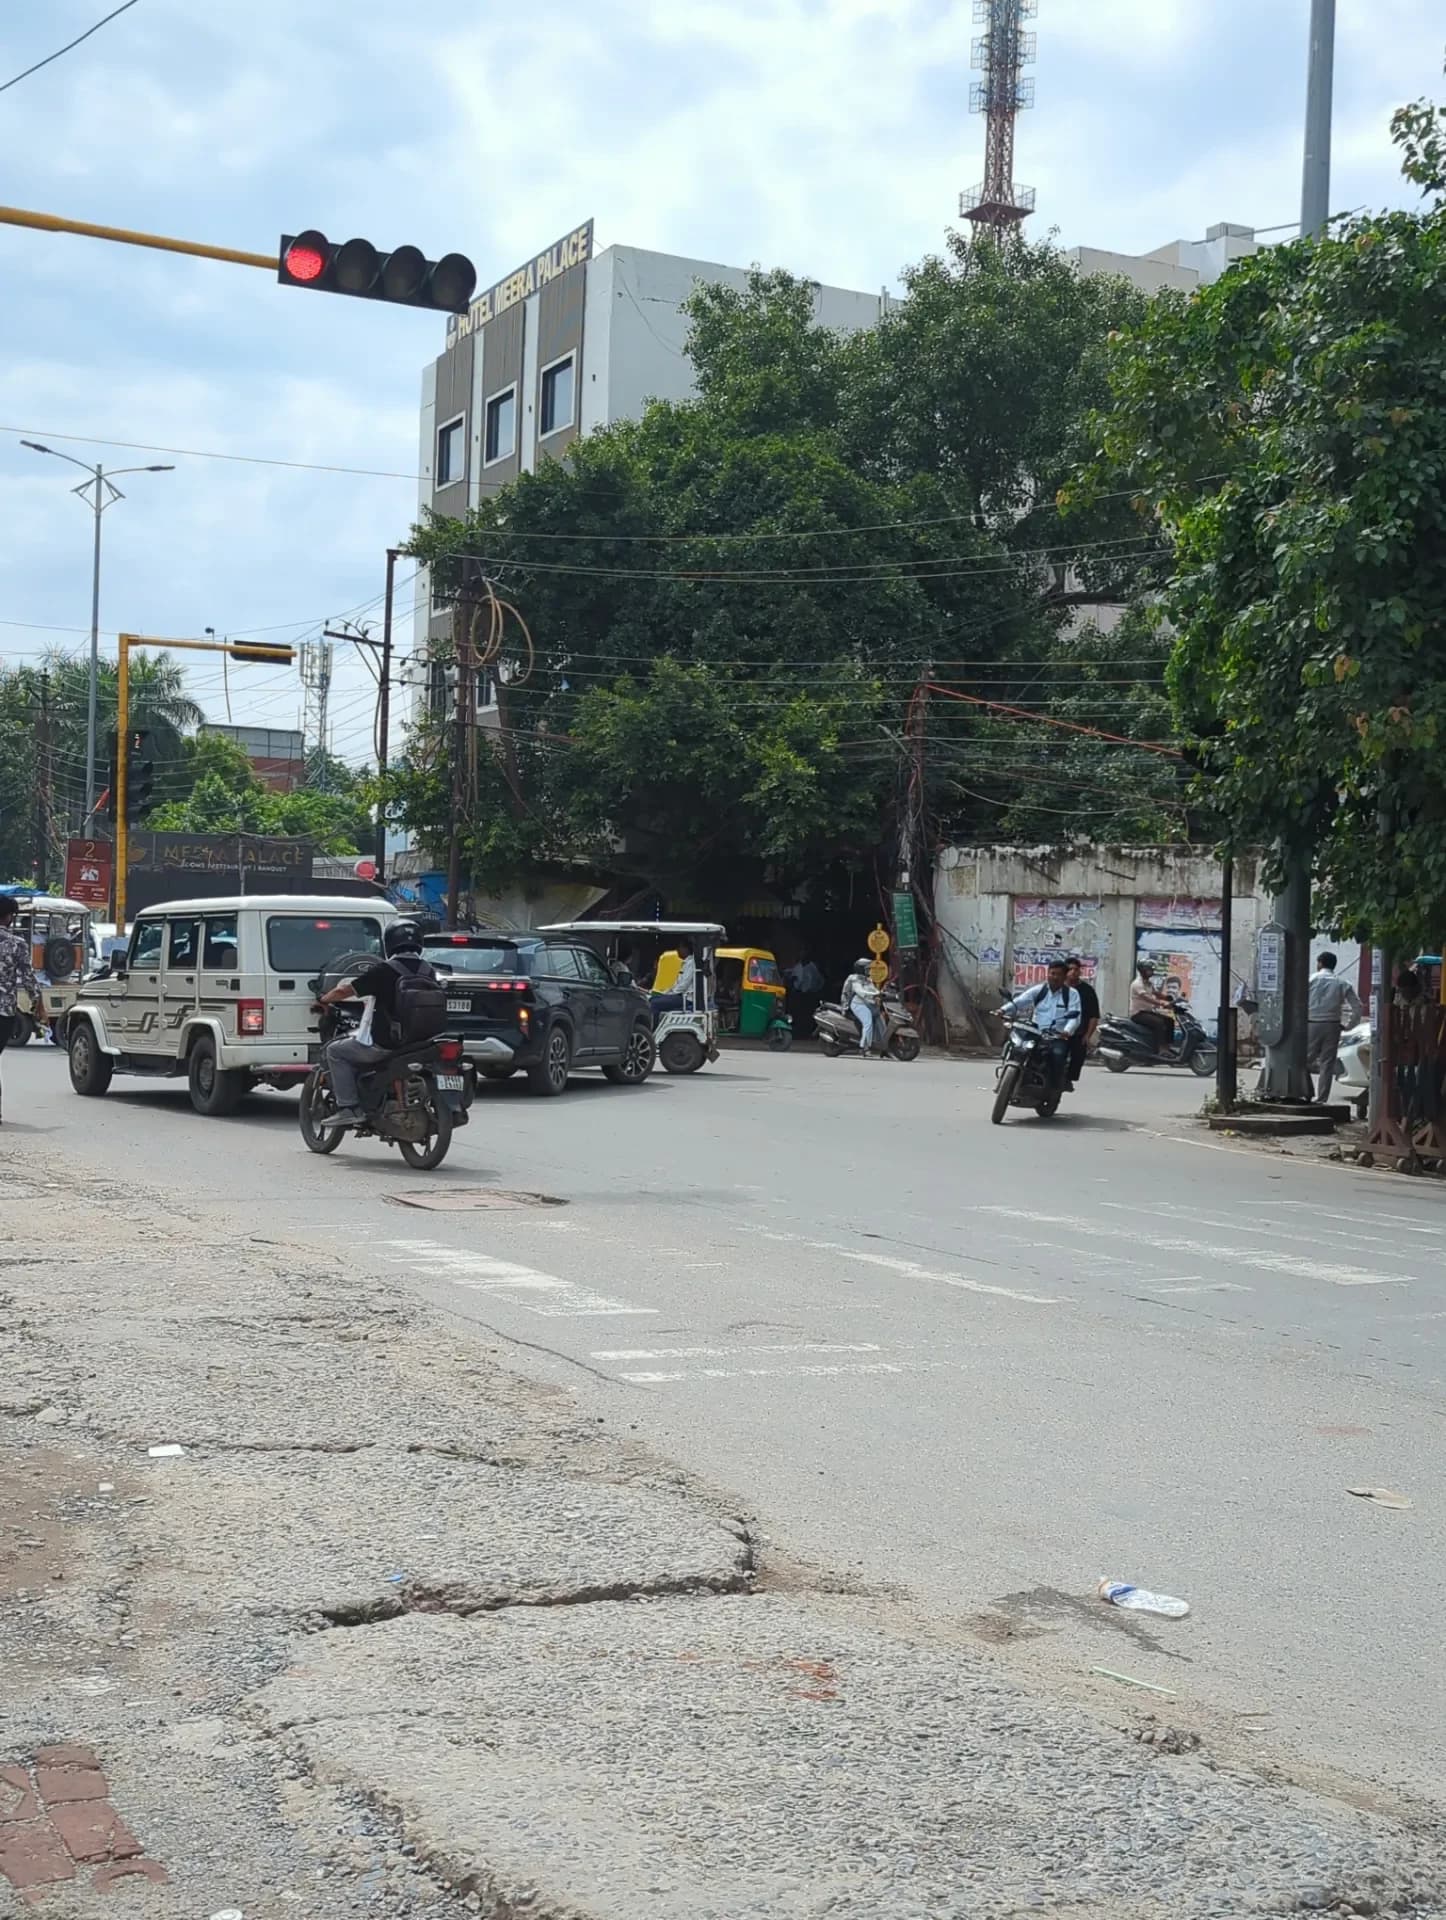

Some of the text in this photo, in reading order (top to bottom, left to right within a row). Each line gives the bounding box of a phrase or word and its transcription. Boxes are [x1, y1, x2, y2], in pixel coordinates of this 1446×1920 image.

[458, 226, 588, 340] HOTEL MEERA PALACE
[85, 841, 95, 857] 2
[238, 848, 304, 864] ALACE
